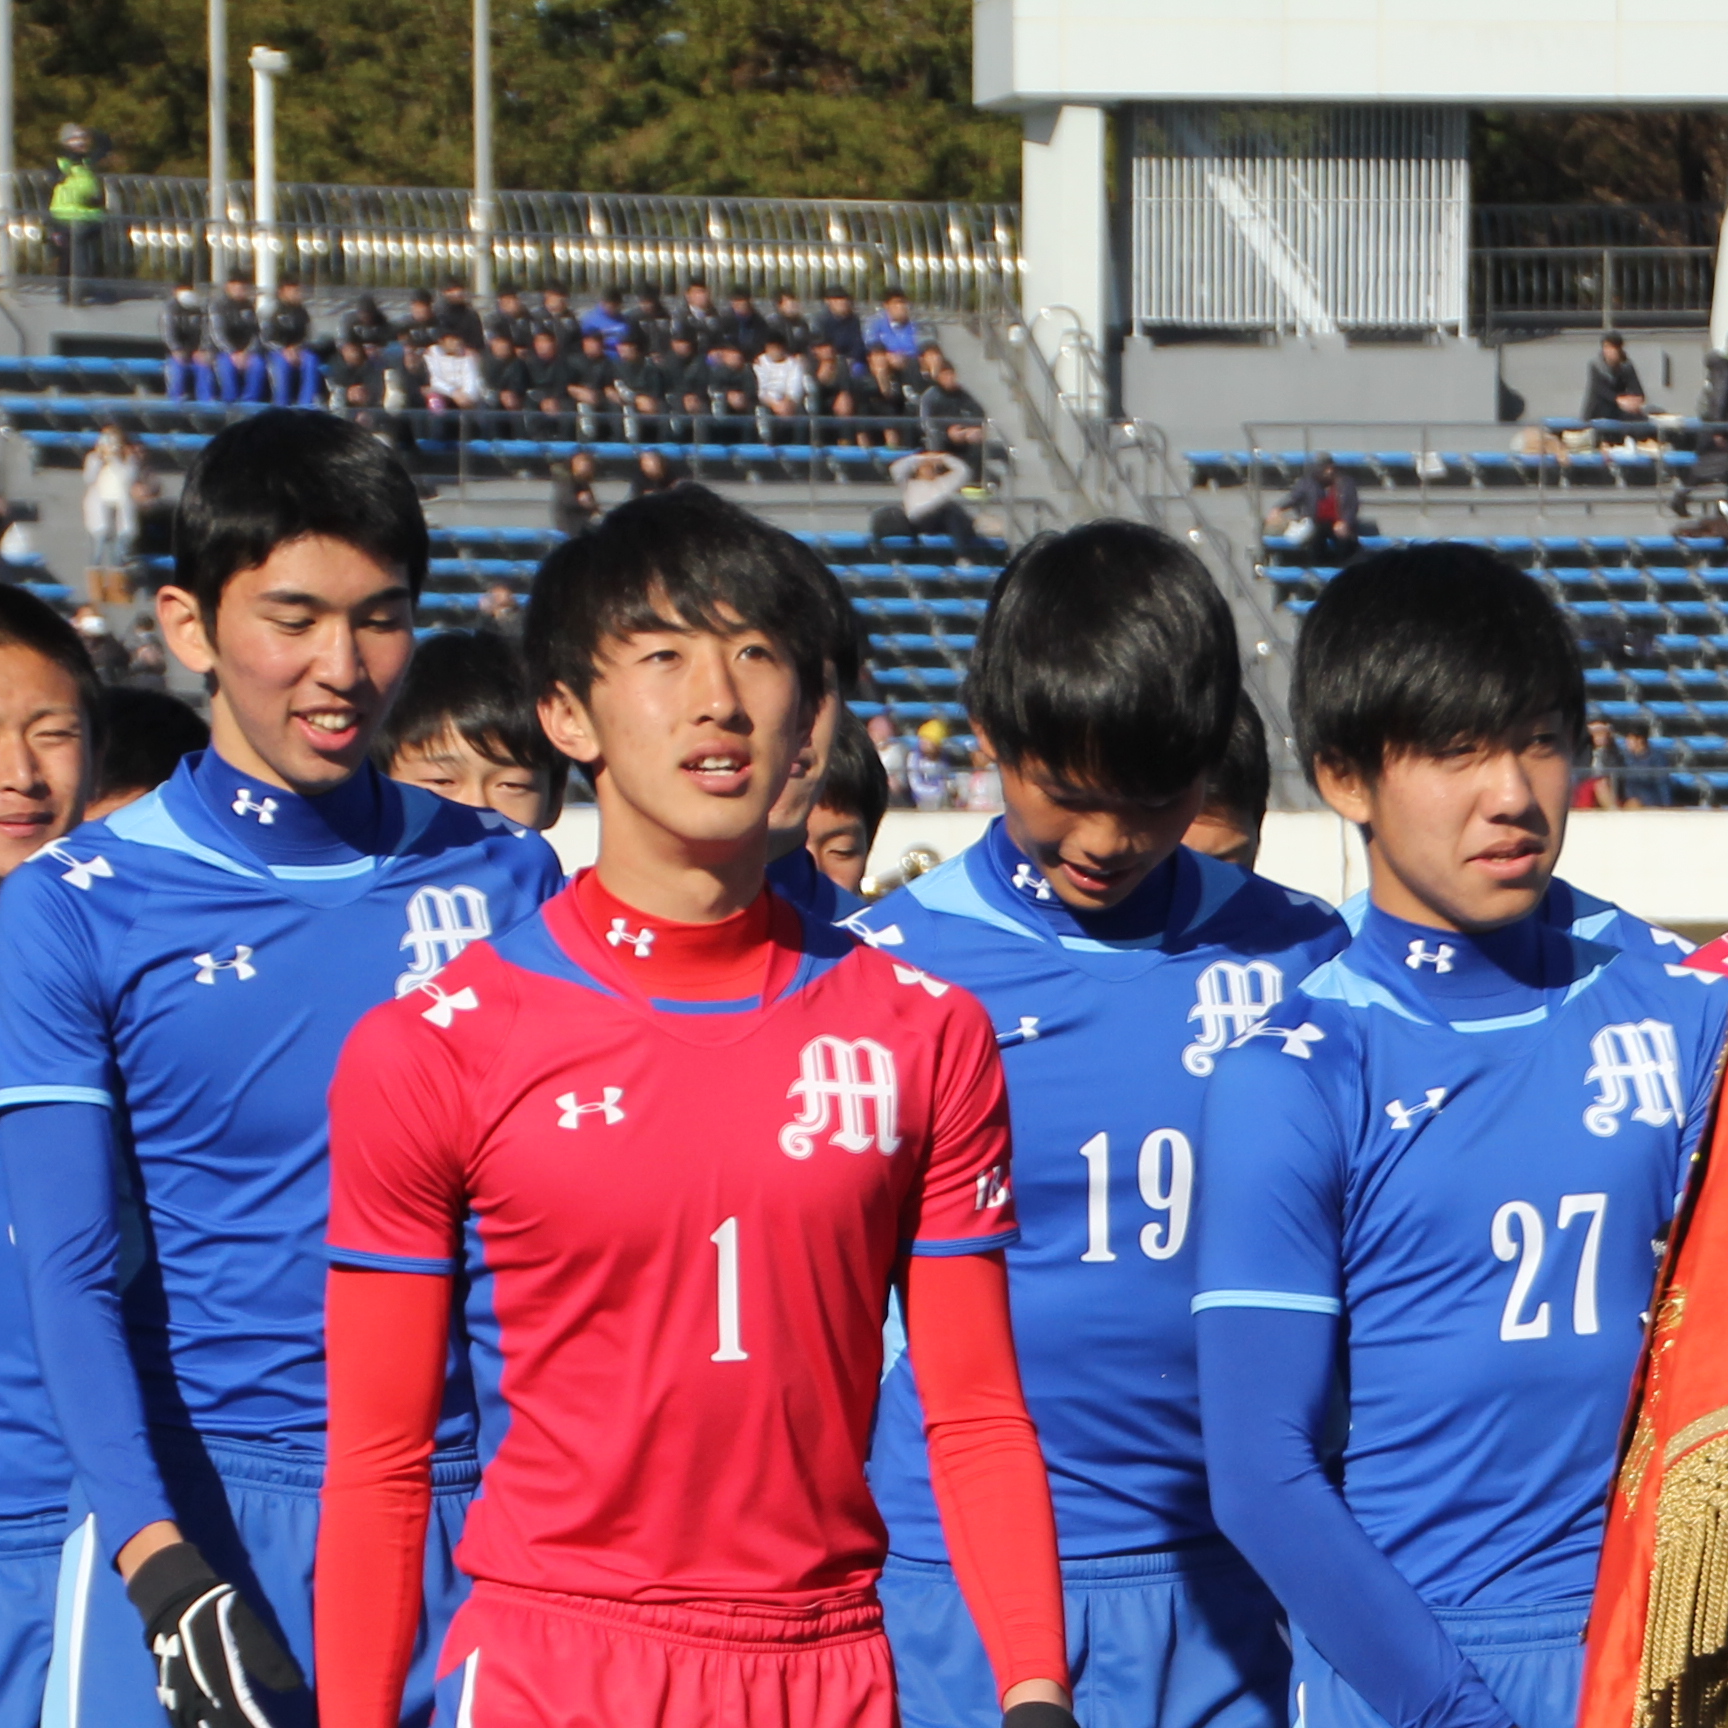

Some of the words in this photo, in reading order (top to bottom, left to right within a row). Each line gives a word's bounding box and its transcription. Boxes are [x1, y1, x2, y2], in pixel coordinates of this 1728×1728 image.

[1079, 1128, 1194, 1262] 19
[1491, 1192, 1608, 1343] 27
[709, 1216, 749, 1363] 1
